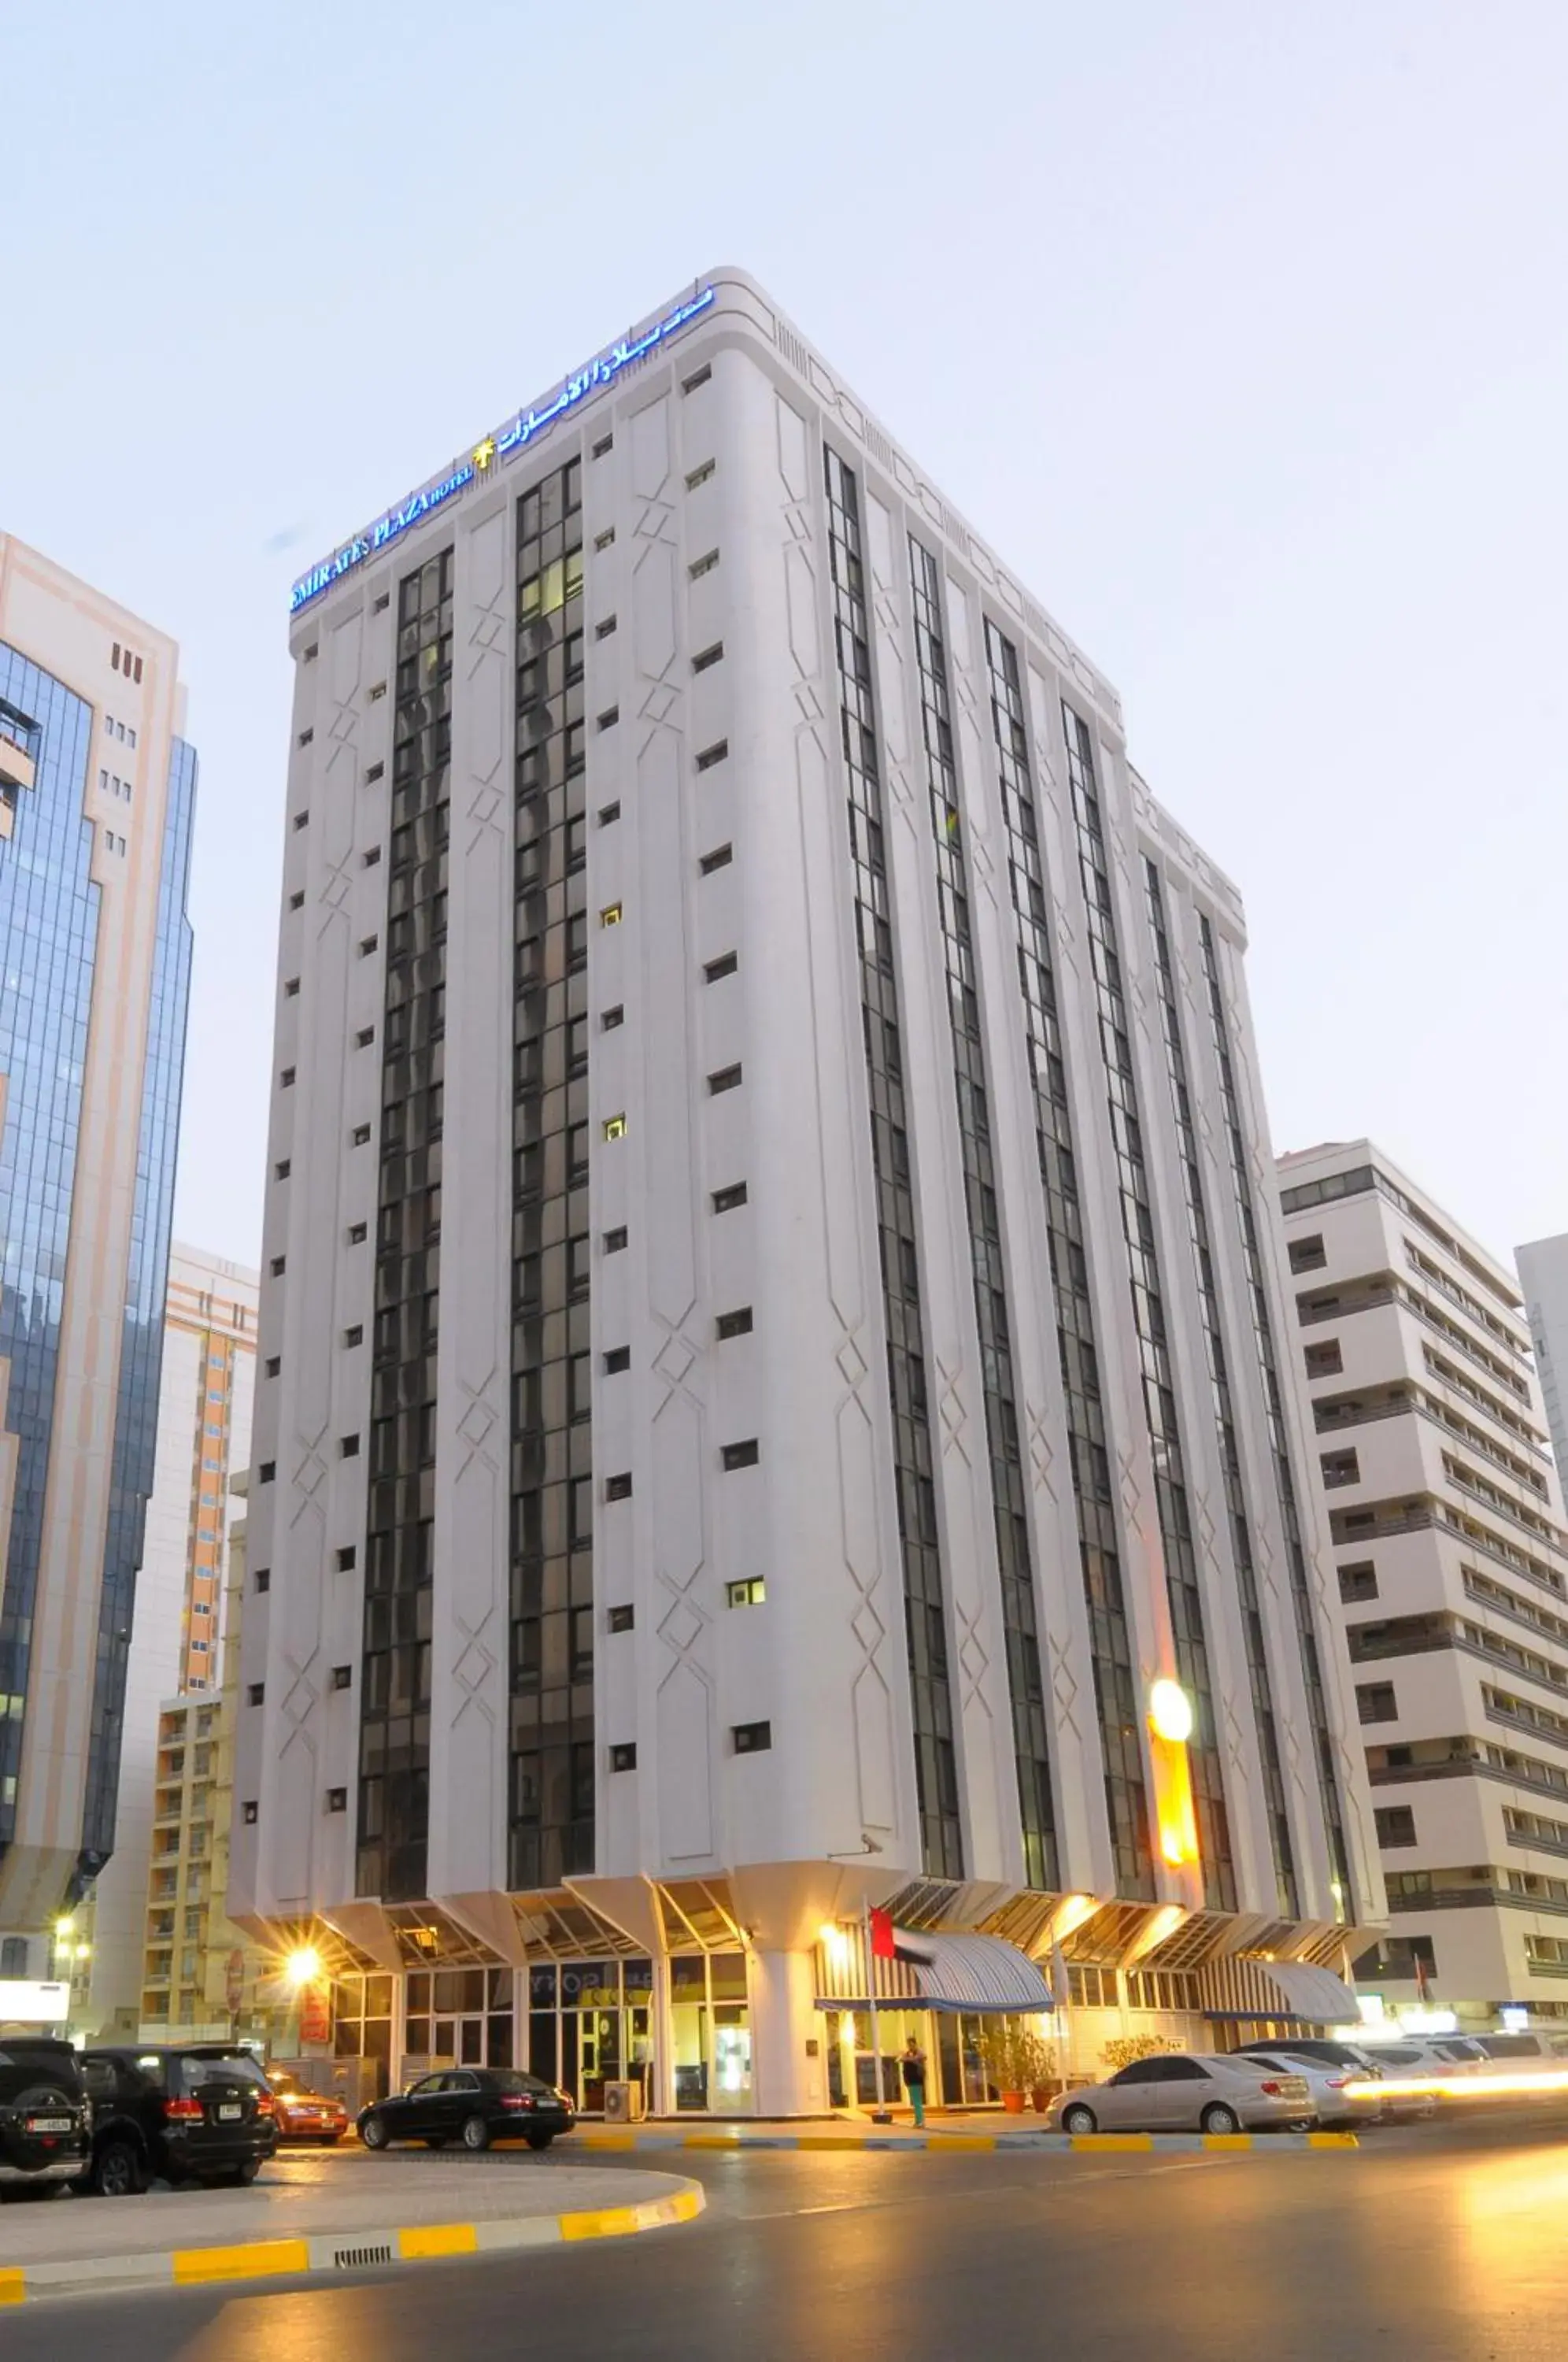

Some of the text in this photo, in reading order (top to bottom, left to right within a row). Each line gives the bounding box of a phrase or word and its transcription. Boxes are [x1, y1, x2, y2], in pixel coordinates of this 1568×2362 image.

[290, 465, 475, 613] EMIRATES PLAZA HOTEL
